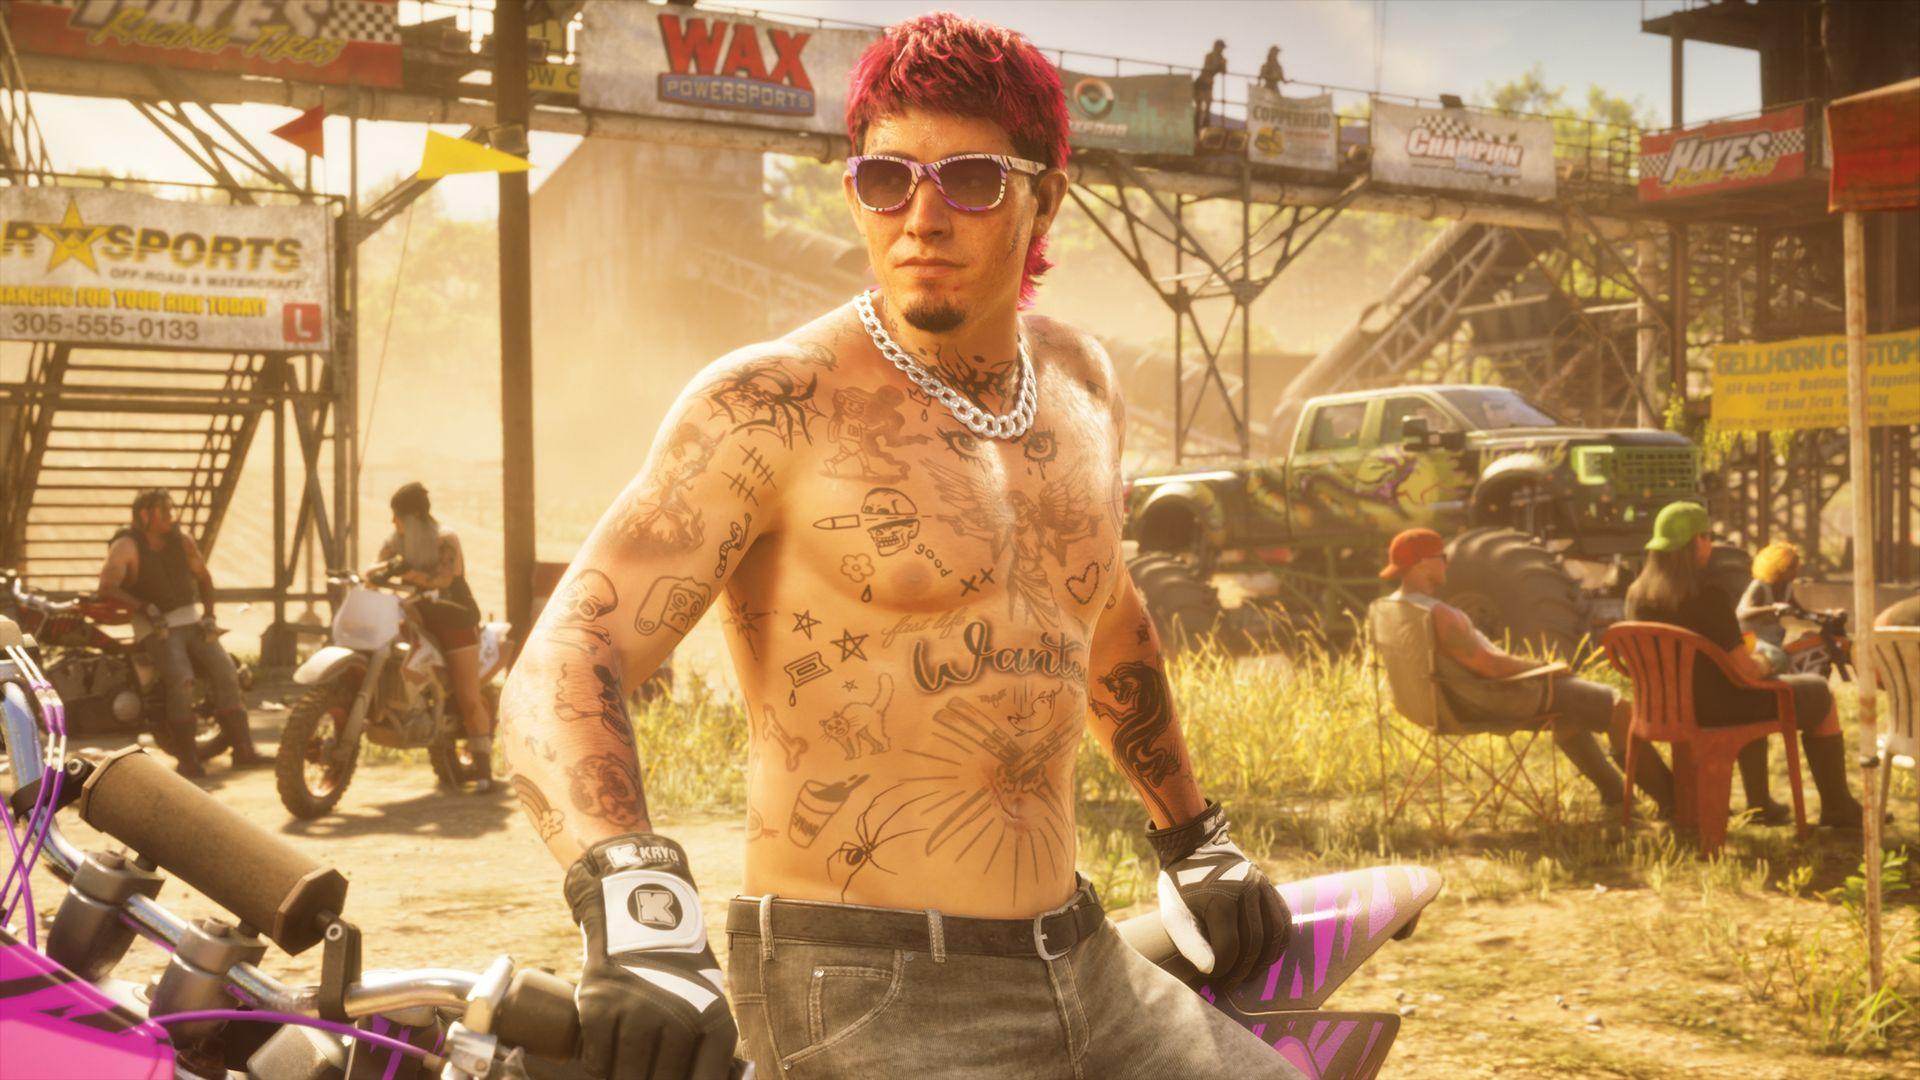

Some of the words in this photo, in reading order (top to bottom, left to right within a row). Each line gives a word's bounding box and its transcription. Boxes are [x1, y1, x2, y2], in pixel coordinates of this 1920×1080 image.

[658, 14, 813, 90] WAX
[667, 80, 811, 109] POWERSPORTS
[1406, 127, 1523, 166] CHAMPION
[1662, 134, 1771, 182] HAYES
[104, 224, 303, 273] SPORTS
[76, 287, 110, 308] FOR
[114, 289, 161, 312] YOUR
[12, 312, 199, 341] 305-555-0133
[914, 543, 953, 578] good
[635, 890, 676, 927] K
